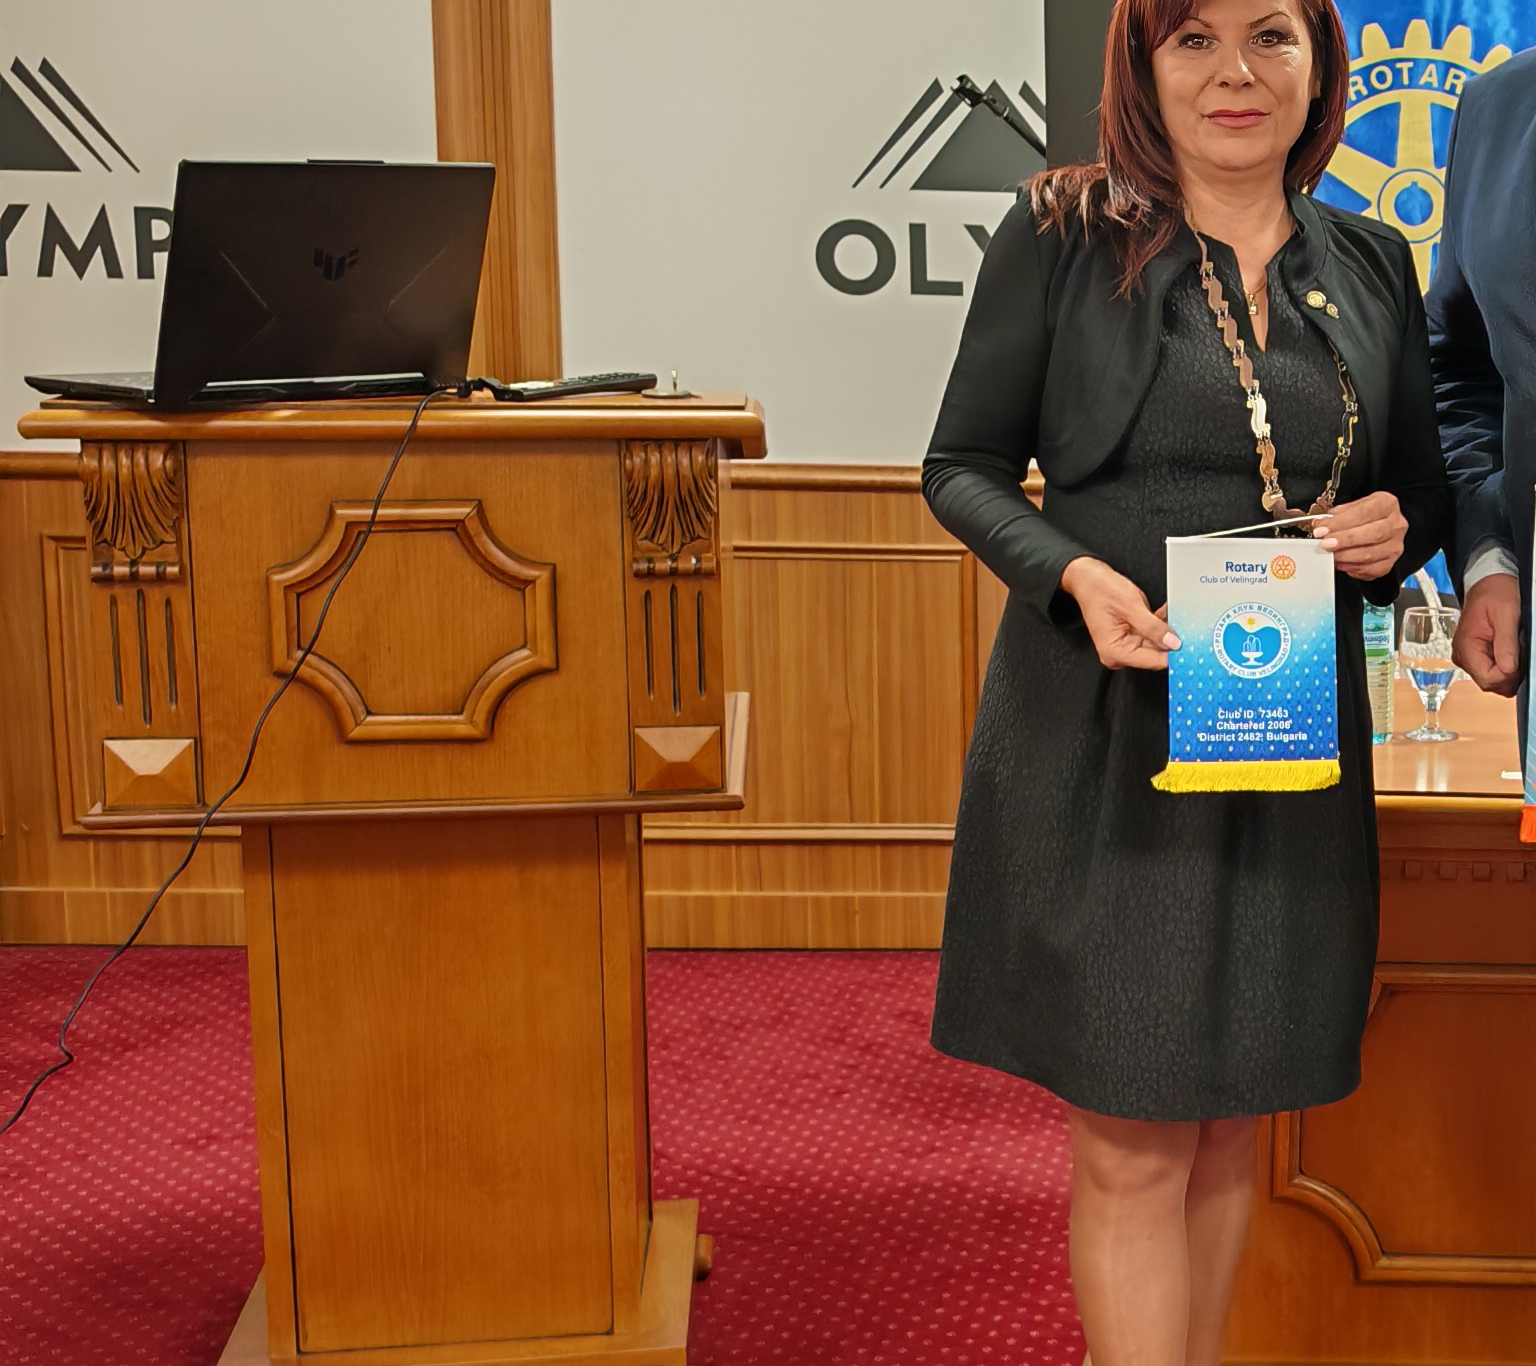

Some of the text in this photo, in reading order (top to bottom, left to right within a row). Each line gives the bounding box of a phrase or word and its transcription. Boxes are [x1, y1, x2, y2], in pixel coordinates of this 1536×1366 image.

[1225, 561, 1267, 574] Rotary
[1200, 576, 1268, 585] Club of Velingrad
[1218, 710, 1241, 719] Club
[1216, 721, 1291, 730] Chartered 2006
[1199, 733, 1235, 742] District
[1266, 732, 1308, 743] Bulgaria
